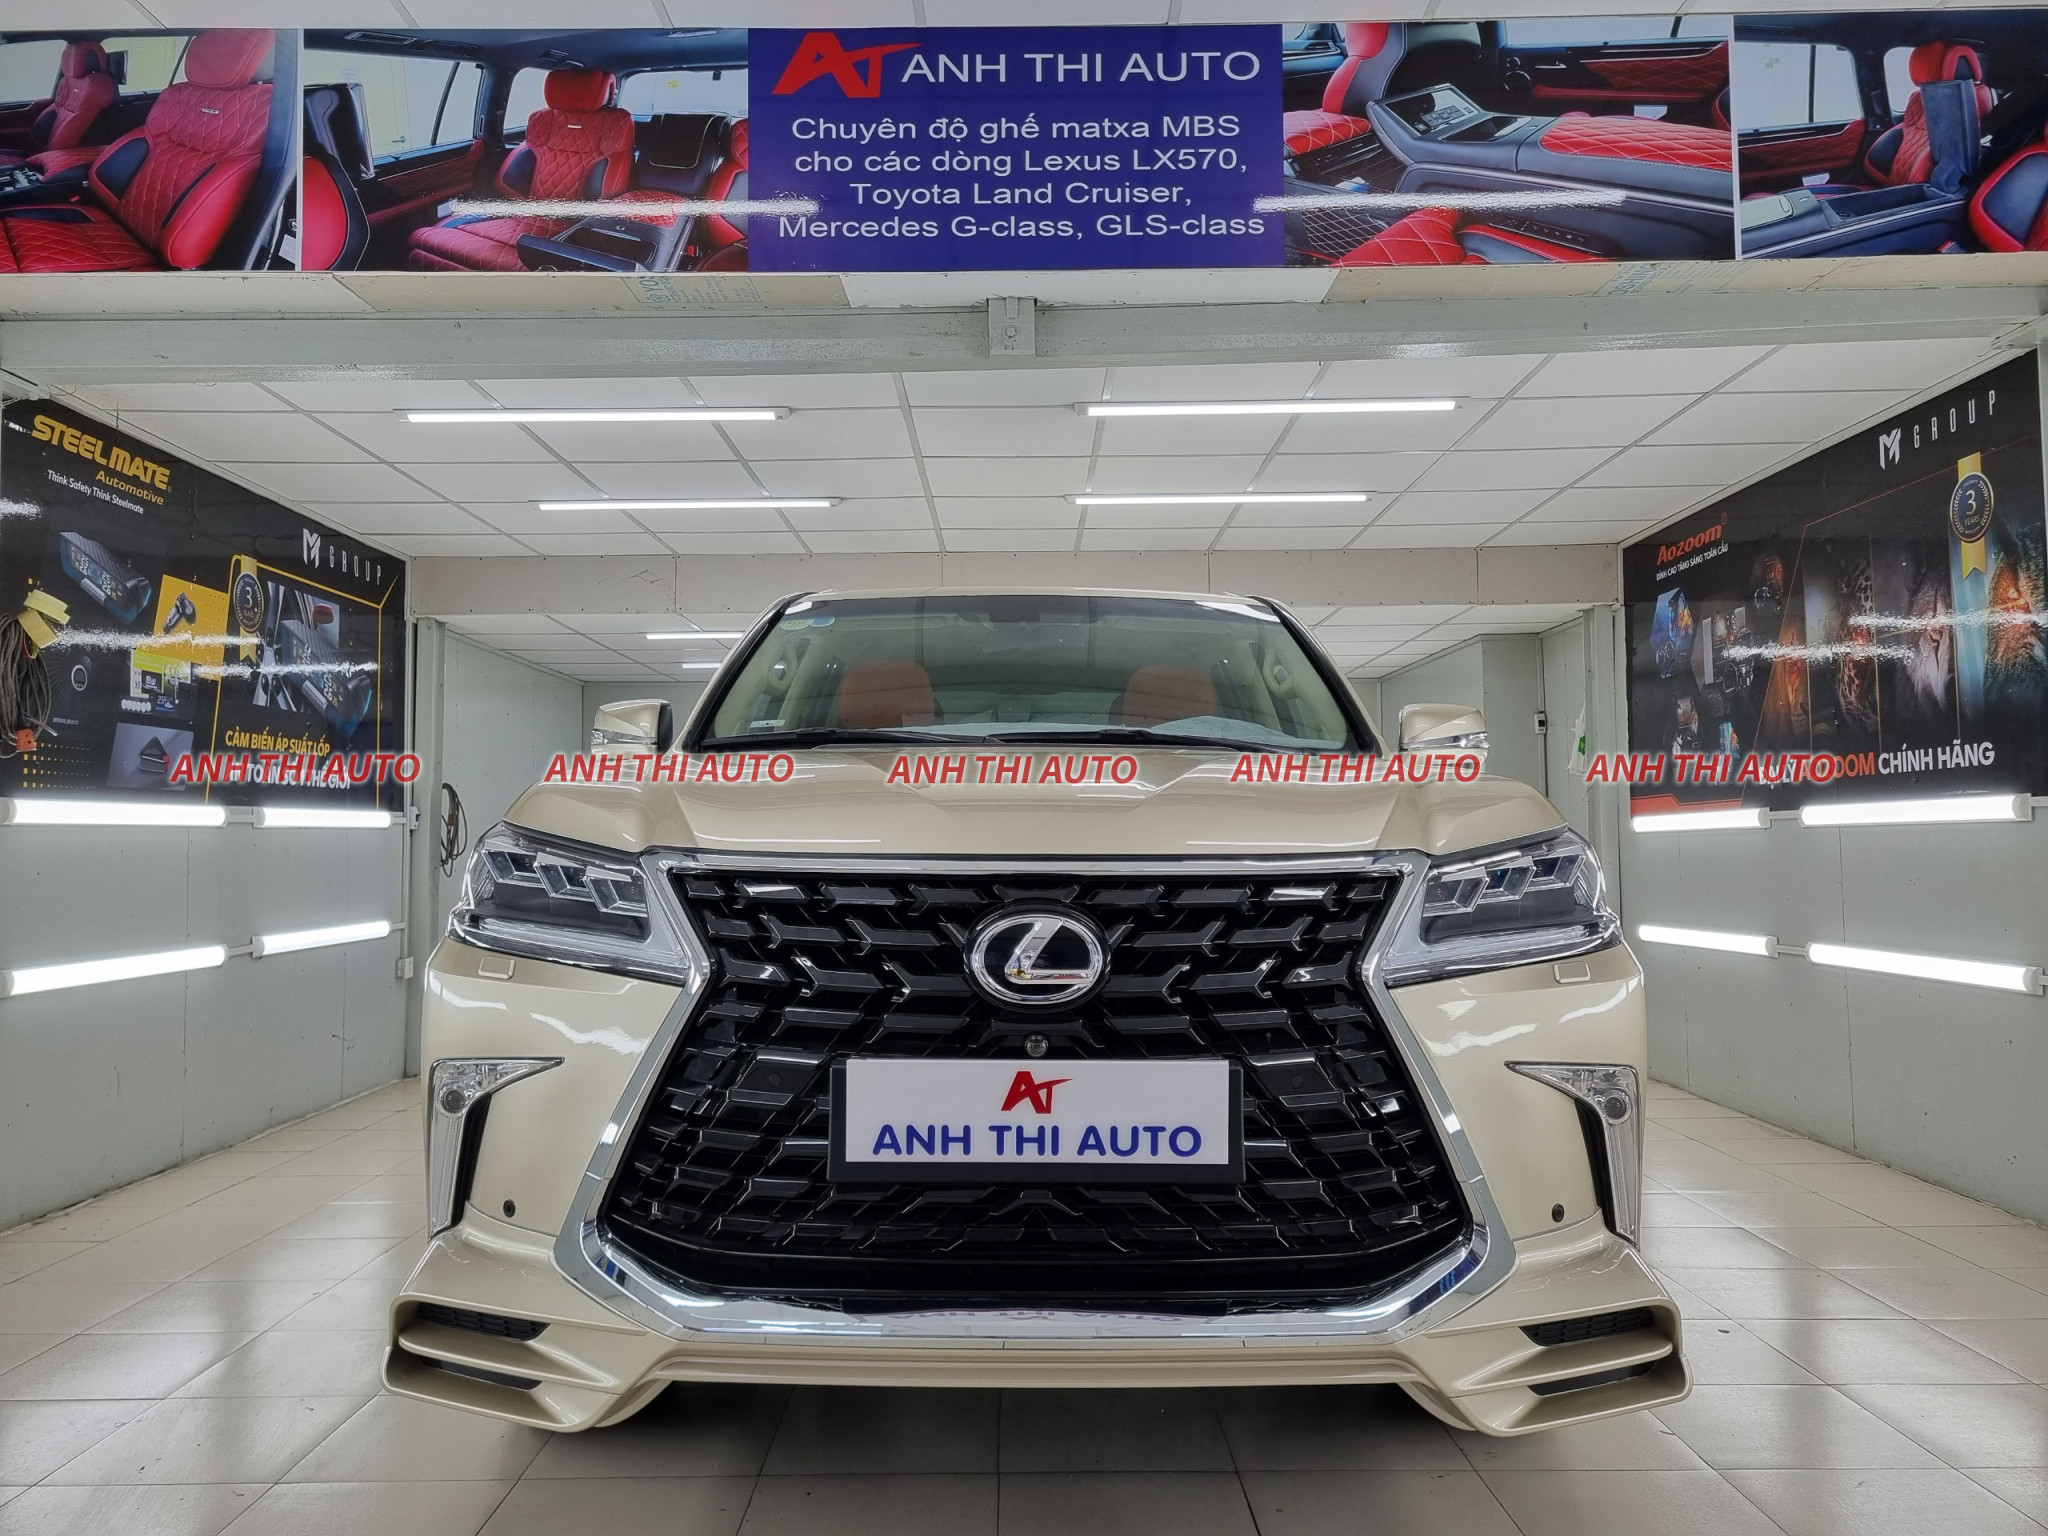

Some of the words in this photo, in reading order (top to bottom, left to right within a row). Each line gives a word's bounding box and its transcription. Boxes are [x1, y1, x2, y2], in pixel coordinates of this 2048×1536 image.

[902, 54, 1007, 83] ANH
[1024, 53, 1102, 82] THI
[1120, 51, 1260, 82] AUTO
[792, 117, 917, 145] Chuyên
[928, 116, 968, 144] độ
[980, 112, 1040, 144] ghế
[1052, 118, 1150, 138] matxa
[1163, 115, 1240, 137] MBS
[795, 150, 853, 172] cho
[864, 150, 921, 172] các
[931, 150, 1011, 177] dòng
[1025, 150, 1121, 171] Lexus
[1133, 148, 1247, 173] LX570,
[850, 183, 961, 210] Toyota
[974, 182, 1052, 204] Land
[1065, 181, 1192, 207] Cruiser,
[779, 214, 939, 238] Mercedes
[951, 215, 1084, 240] G-class,
[1096, 213, 1267, 236] GLS-class
[1913, 390, 1995, 448] GROUP
[48, 469, 68, 486] Think
[69, 478, 92, 497] Safety
[93, 486, 112, 501] Think
[112, 494, 144, 515] Steelmate
[95, 470, 164, 505] Automotive
[1965, 489, 1976, 515] 3
[1656, 524, 1722, 566] Aozoom
[329, 545, 382, 586] GROUP
[245, 586, 253, 609] 3
[225, 726, 250, 749] CẢM
[251, 726, 275, 751] BIẾN
[275, 731, 289, 752] ÁP
[289, 732, 313, 755] SUẤT
[313, 734, 331, 757] LỐP
[1878, 743, 1933, 775] CHÍNH
[1938, 739, 1995, 770] HÃNG
[872, 1124, 971, 1157] ANH
[988, 1124, 1060, 1157] THI
[1076, 1124, 1203, 1158] AUTO
